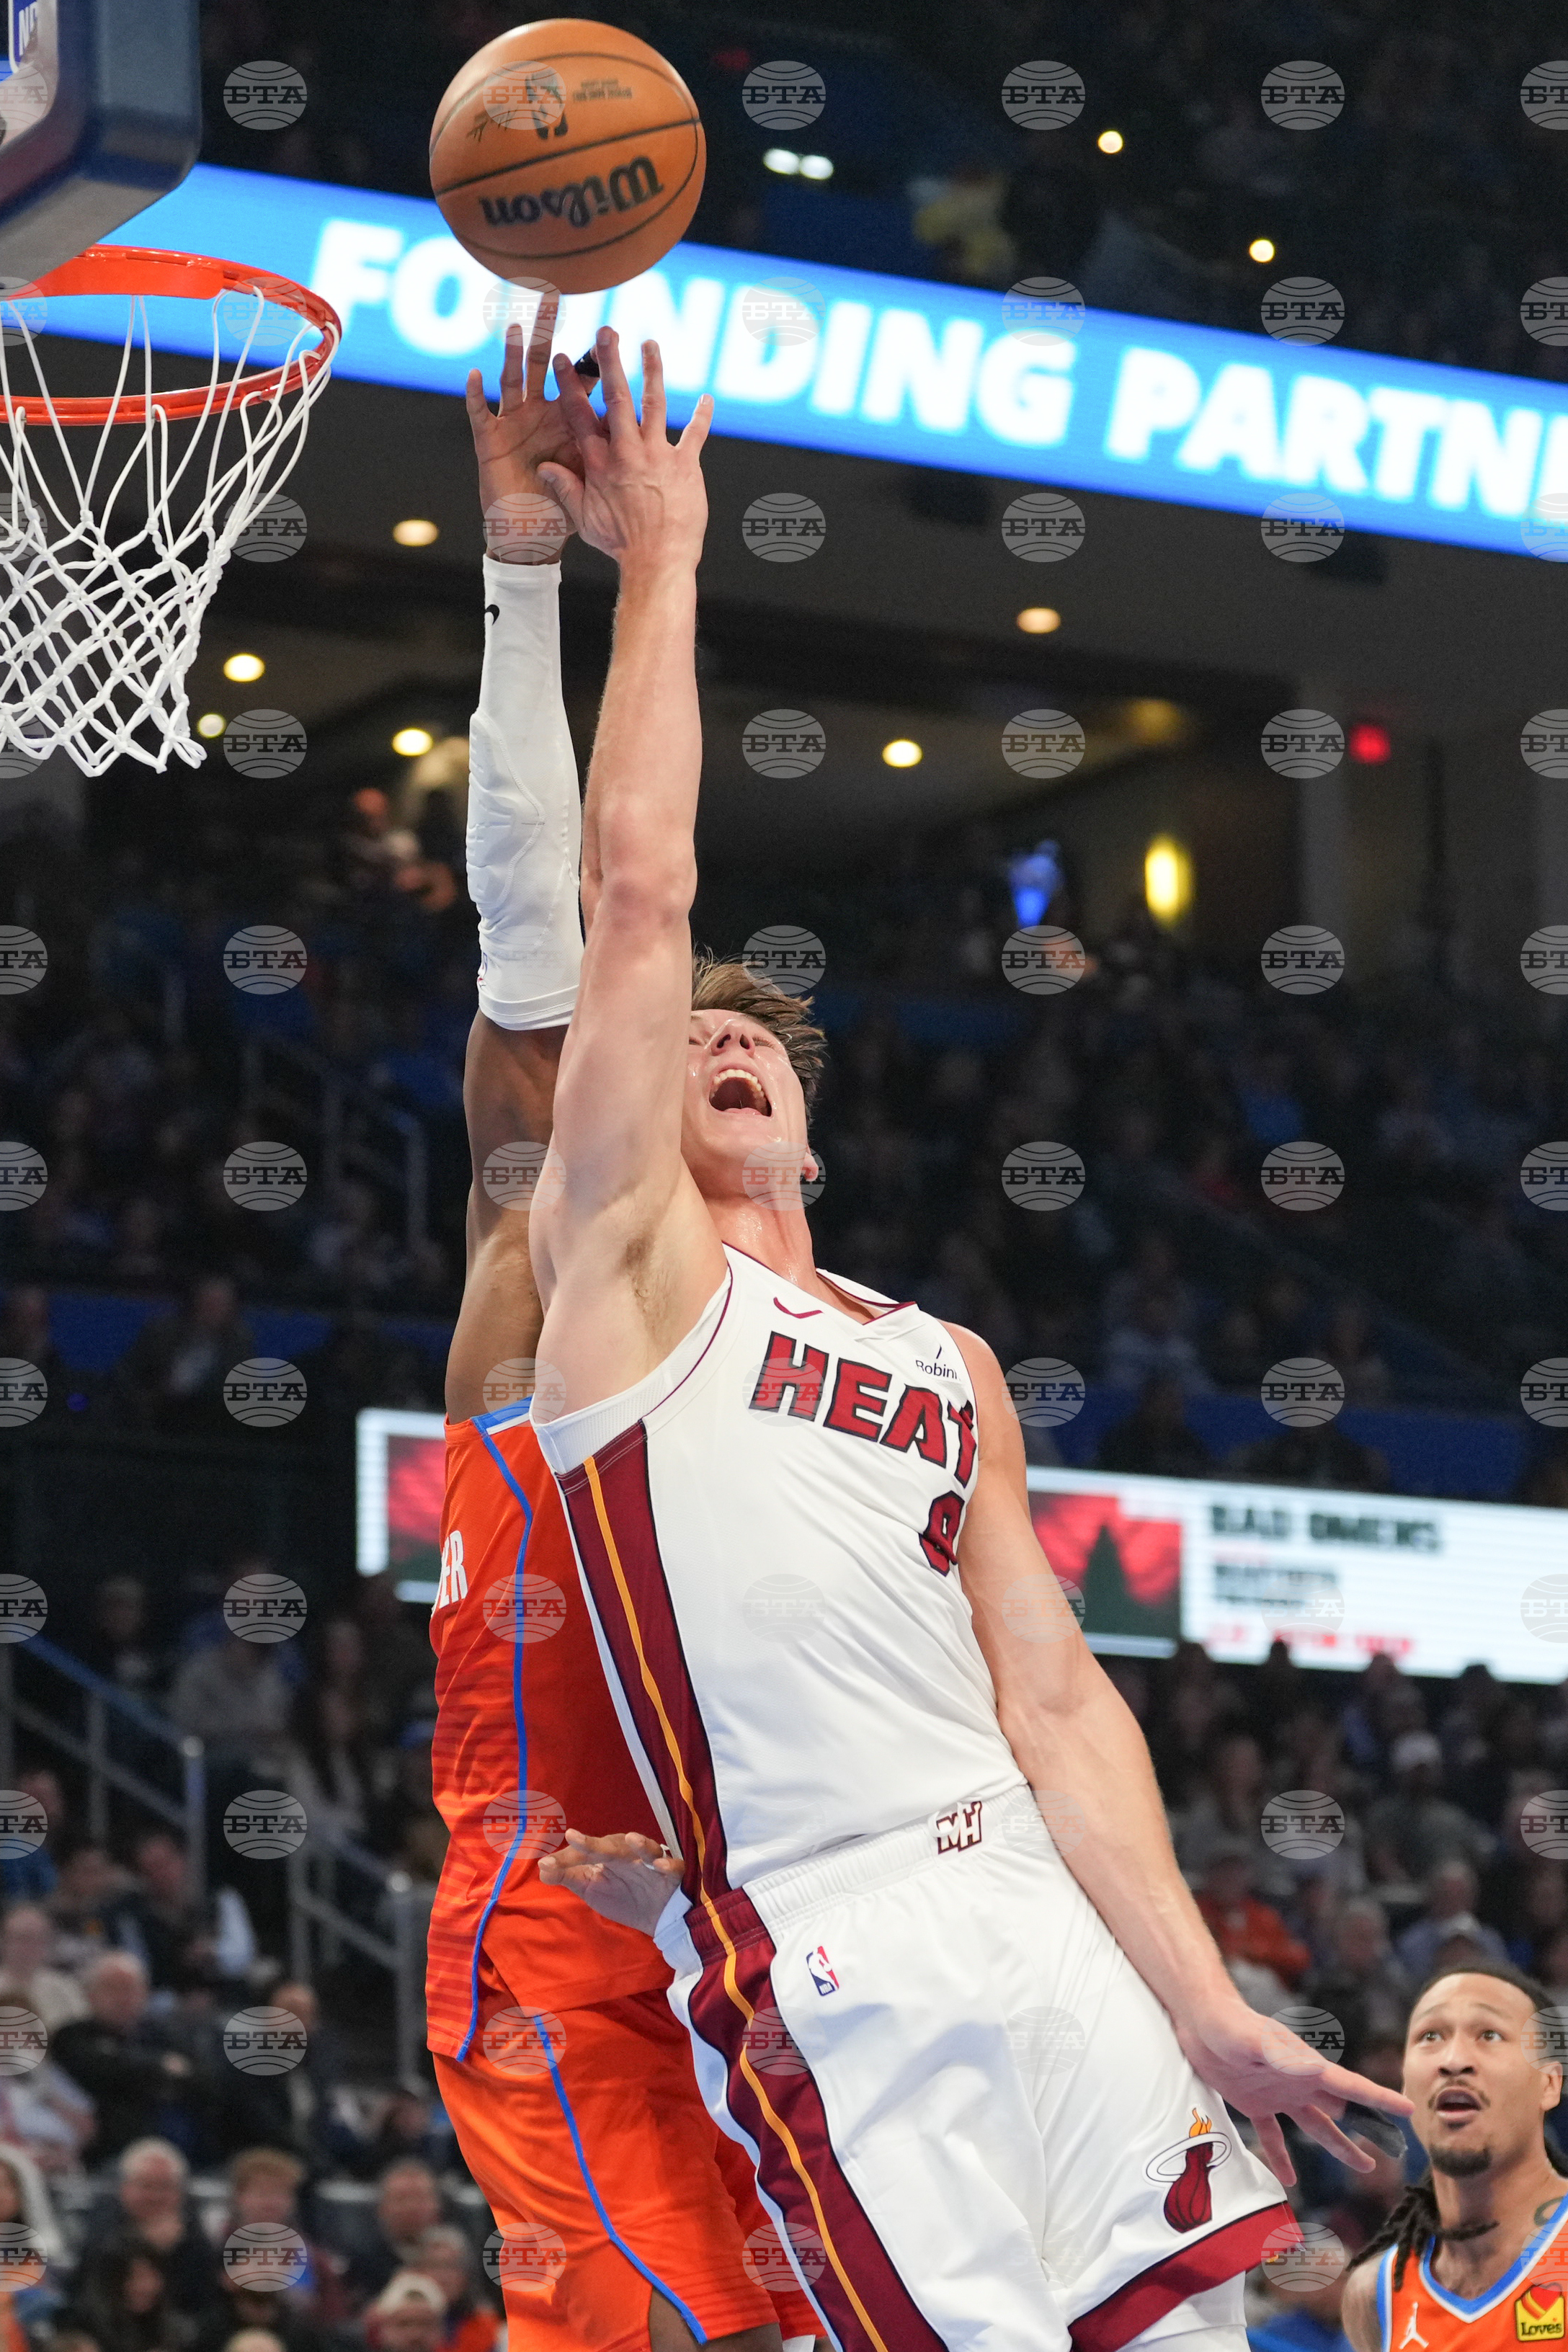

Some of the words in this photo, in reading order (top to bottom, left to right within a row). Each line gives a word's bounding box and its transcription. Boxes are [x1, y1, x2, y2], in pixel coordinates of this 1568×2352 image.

[478, 155, 664, 228] Wilson
[915, 1360, 958, 1379] Robin
[749, 1331, 977, 1489] HEAT
[431, 1530, 468, 1618] ER
